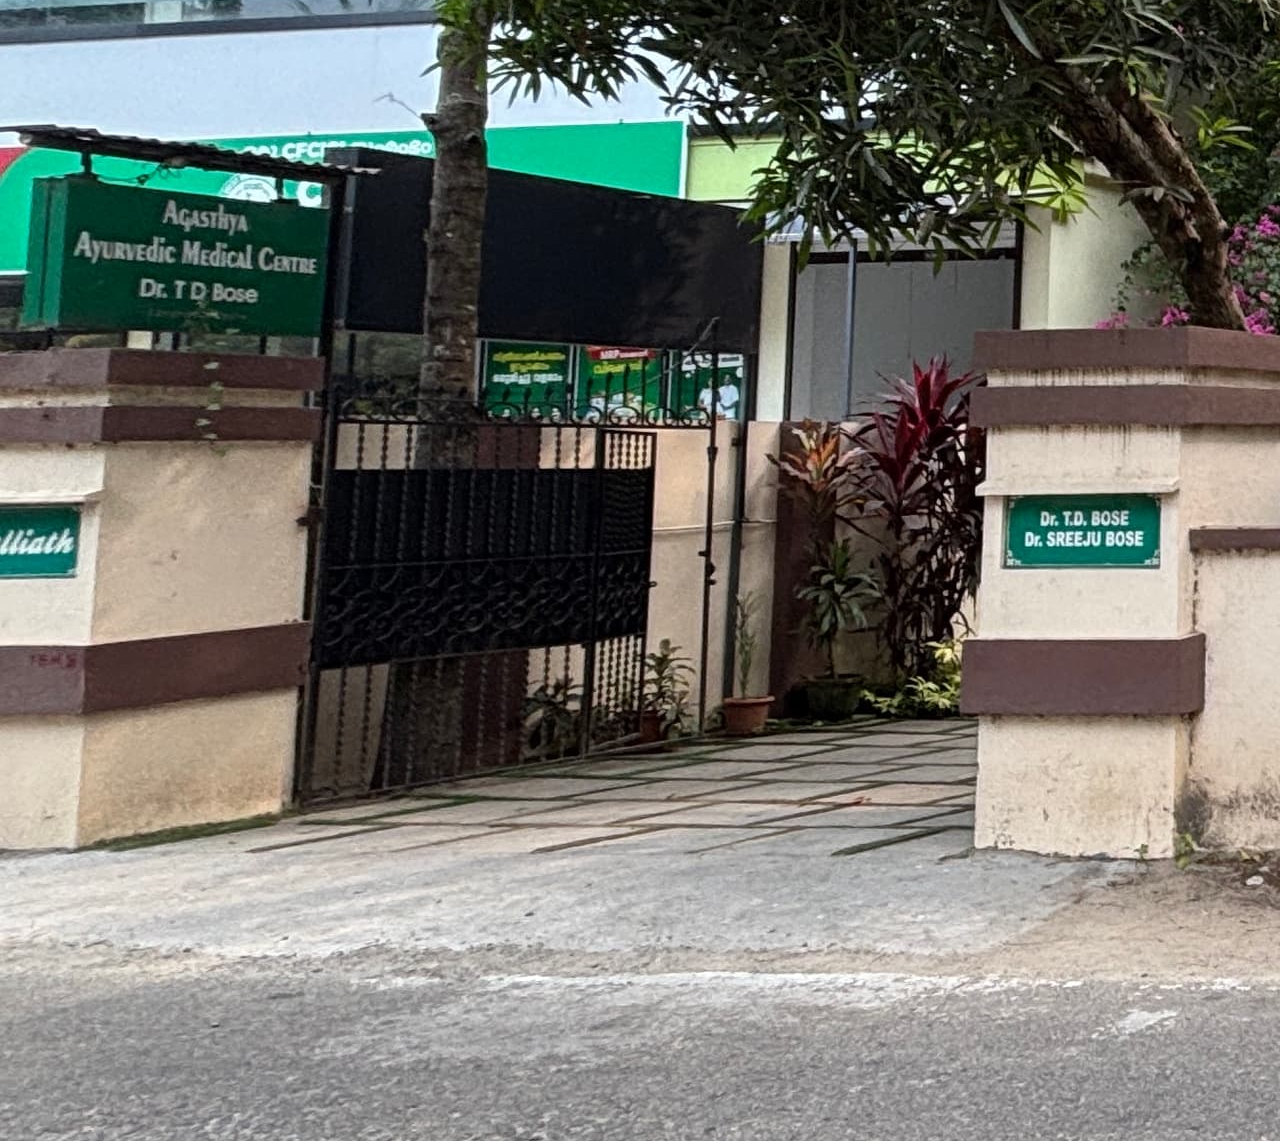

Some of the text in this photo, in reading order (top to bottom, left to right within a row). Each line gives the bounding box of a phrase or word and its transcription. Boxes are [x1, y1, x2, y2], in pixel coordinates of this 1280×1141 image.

[73, 231, 177, 264] Ayurvedic
[181, 240, 253, 269] Medical
[139, 278, 168, 299] Dr.
[174, 280, 187, 299] T
[212, 283, 259, 303] Bose
[1040, 511, 1129, 527] Dr. T.D. BOSE
[0, 528, 75, 555] lliath
[1024, 531, 1145, 548] Dr. SREEJU BOSE
